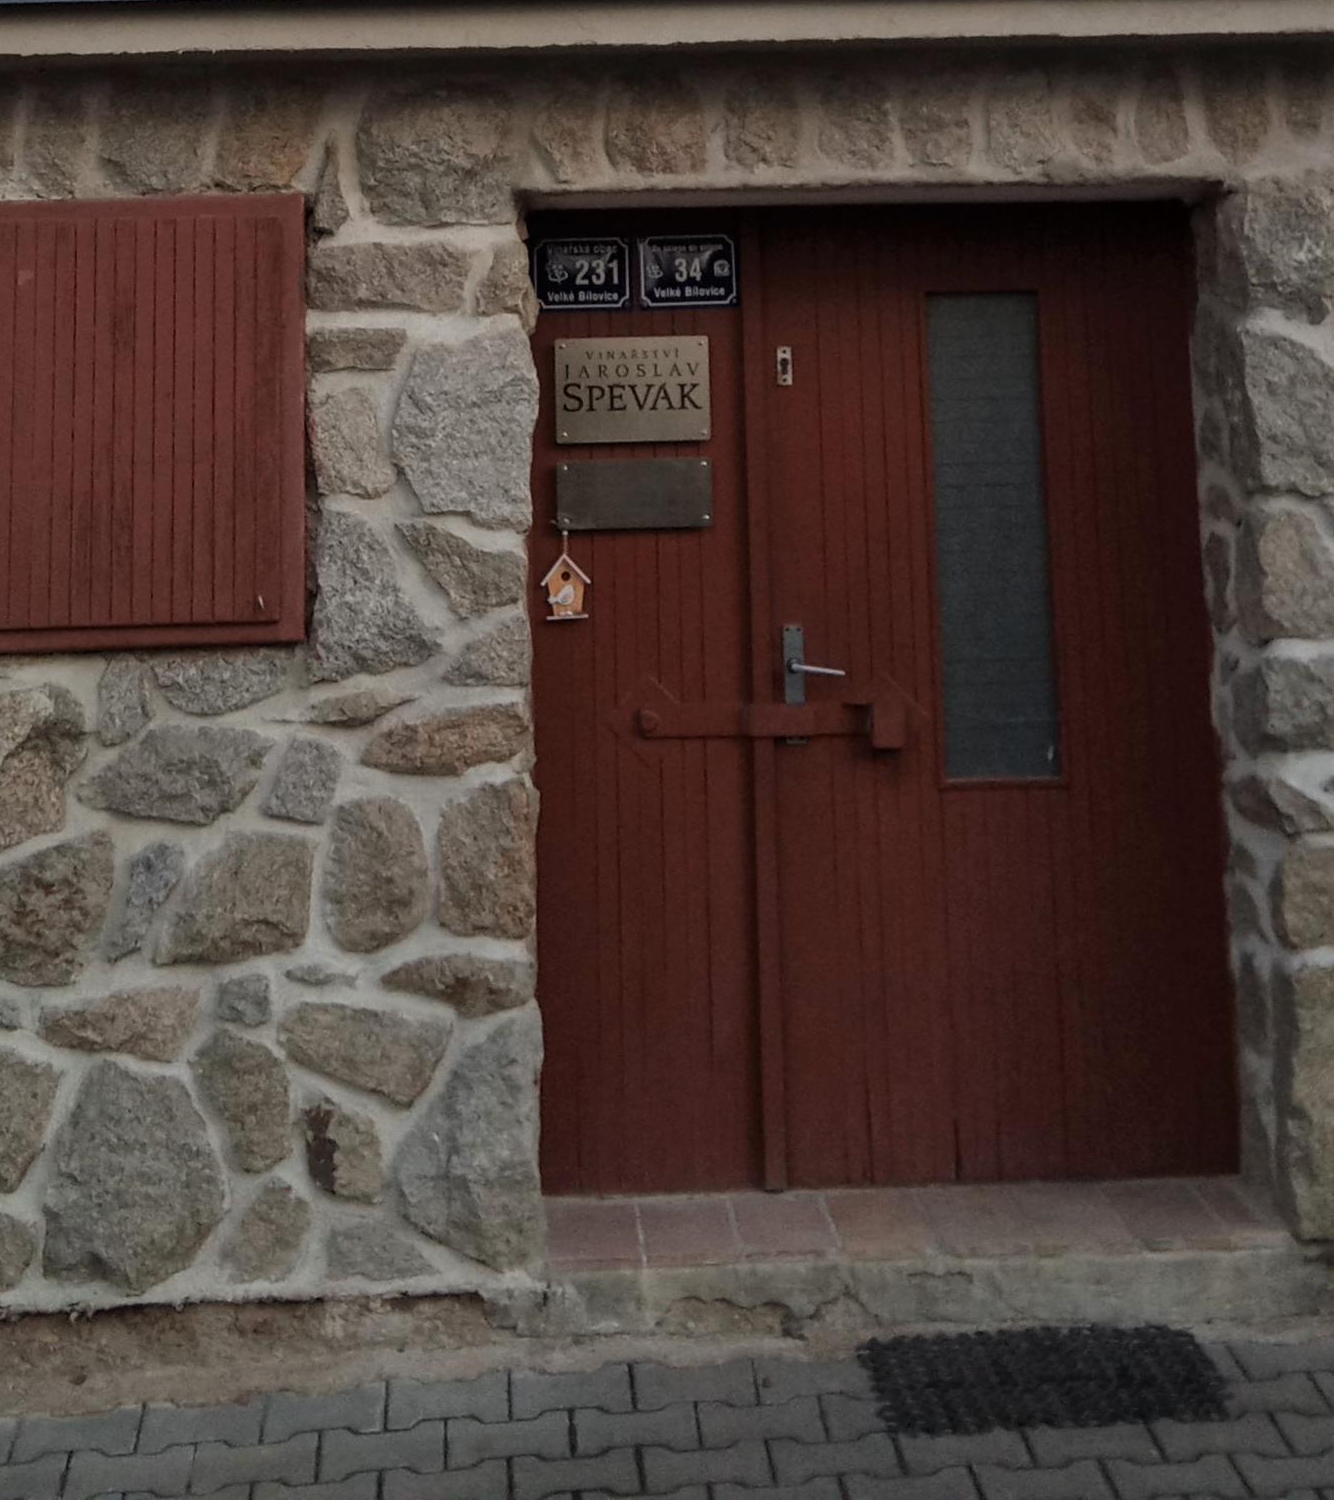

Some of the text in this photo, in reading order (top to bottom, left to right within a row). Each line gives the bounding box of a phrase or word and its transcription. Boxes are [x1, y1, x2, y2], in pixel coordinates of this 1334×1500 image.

[575, 259, 619, 286] 231
[675, 257, 702, 282] 34
[547, 290, 575, 302] Velké
[653, 286, 681, 298] Velké
[564, 362, 700, 380] JAROSLAV
